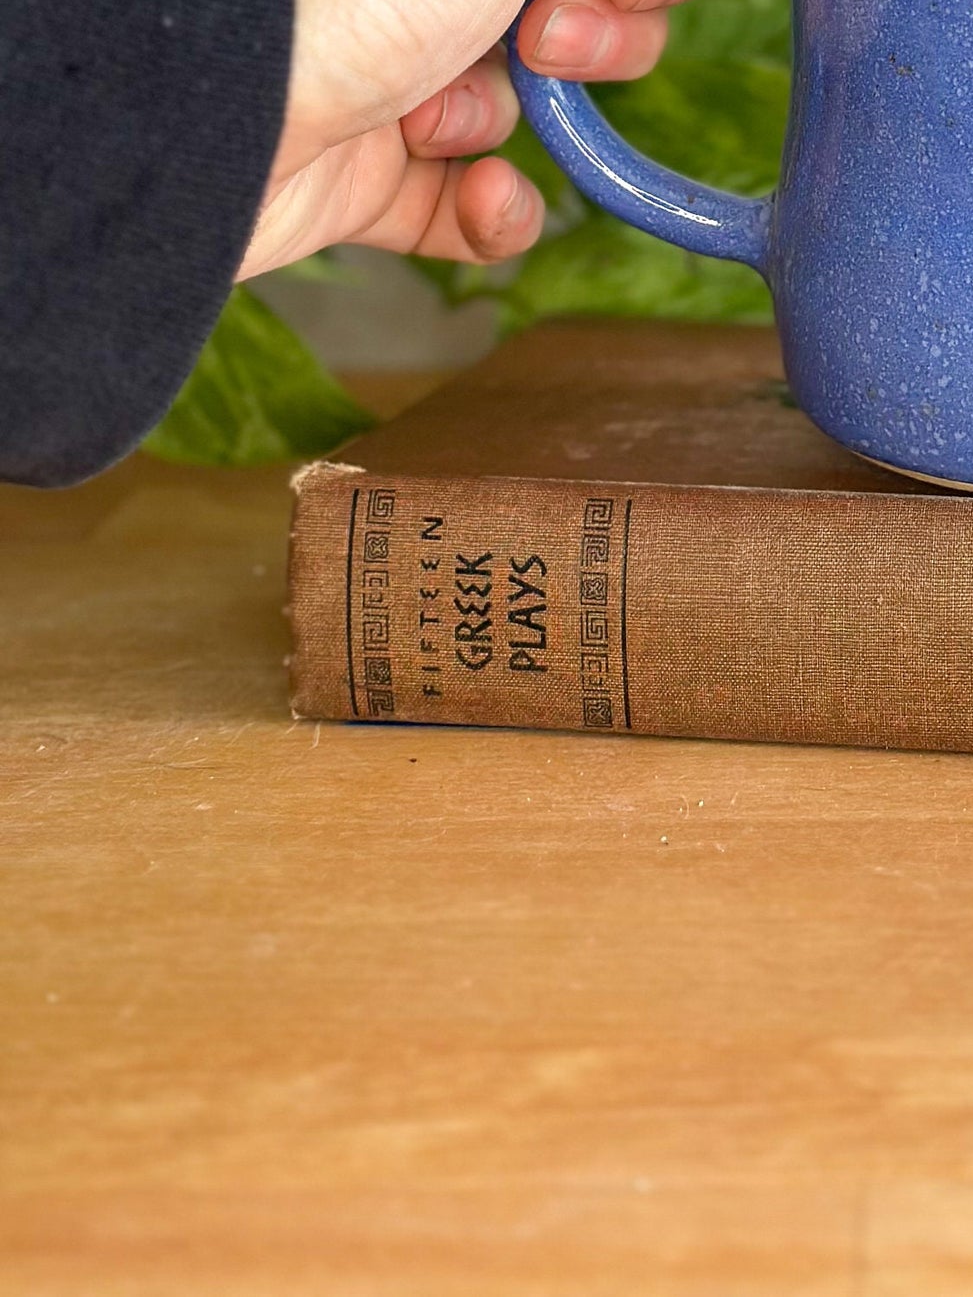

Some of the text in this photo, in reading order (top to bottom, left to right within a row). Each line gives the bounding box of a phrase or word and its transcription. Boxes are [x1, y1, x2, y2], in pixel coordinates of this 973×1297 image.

[420, 516, 444, 697] FIFTEEN
[454, 552, 494, 671] GREEK
[507, 555, 548, 673] PLAYS
